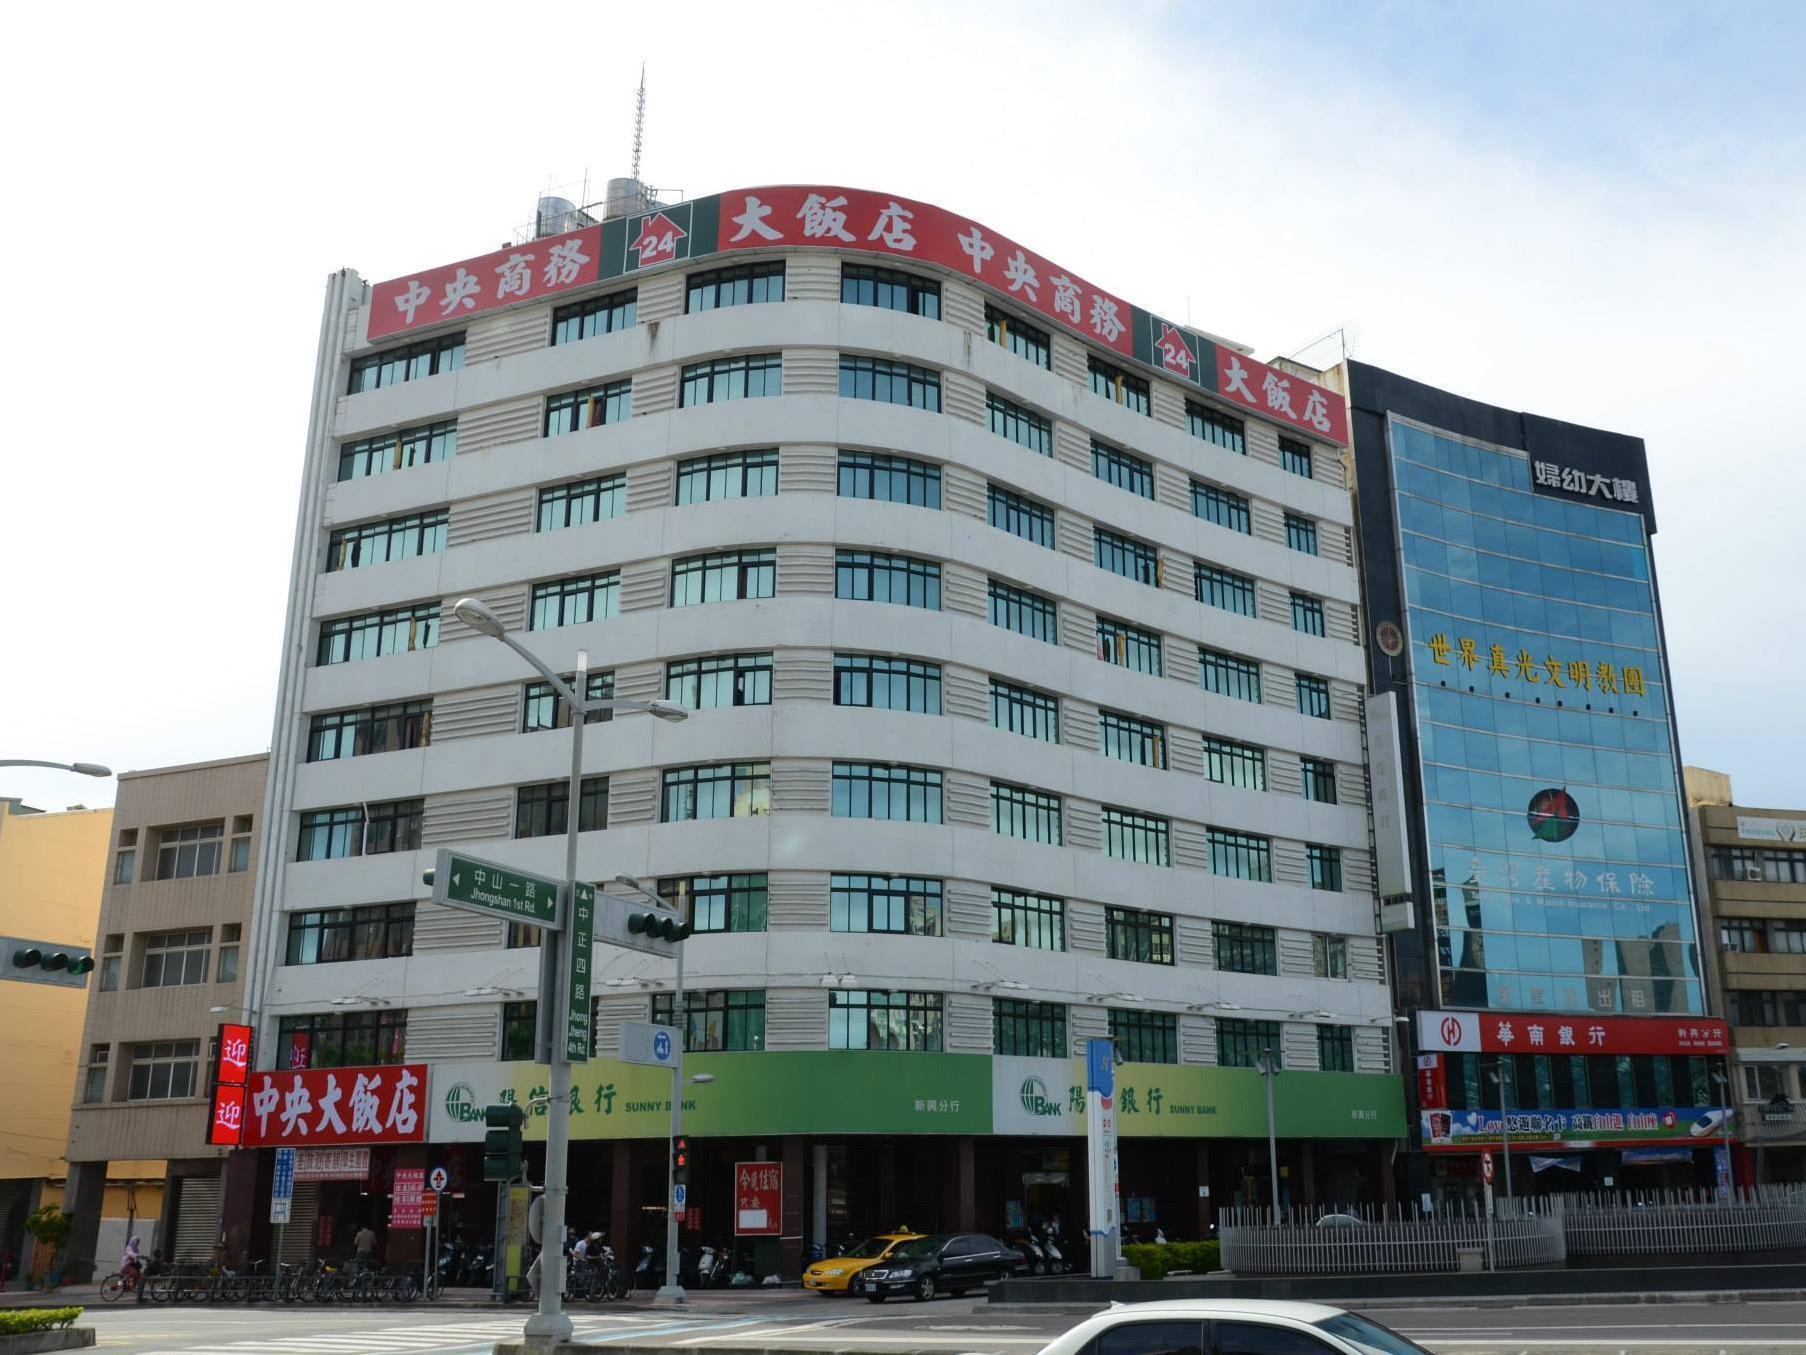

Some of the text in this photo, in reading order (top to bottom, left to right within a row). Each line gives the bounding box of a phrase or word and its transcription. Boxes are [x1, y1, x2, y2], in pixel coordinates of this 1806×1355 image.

[394, 193, 917, 325] 中央商務 24 大飯店
[957, 226, 1332, 434] 中央商務 24 大飯店
[1534, 460, 1640, 504] 婦幼大樓
[474, 868, 536, 899] 中山一路
[470, 887, 512, 907] Jhongshan
[512, 898, 524, 912] 1st
[574, 905, 590, 1000] 中正四路
[569, 1008, 588, 1026] Jhong
[569, 1024, 587, 1041] Jheng
[1497, 1021, 1606, 1046] 華南銀行
[223, 1040, 247, 1068] 迎
[568, 1041, 577, 1054] 4th
[253, 1069, 418, 1138] 中央大飯店
[625, 1100, 696, 1113] SUNNY BNK
[1034, 1096, 1062, 1116] BANK
[1068, 1086, 1163, 1116] 陽銀行
[1170, 1105, 1196, 1115] SUNNY
[216, 1101, 241, 1131] 迎
